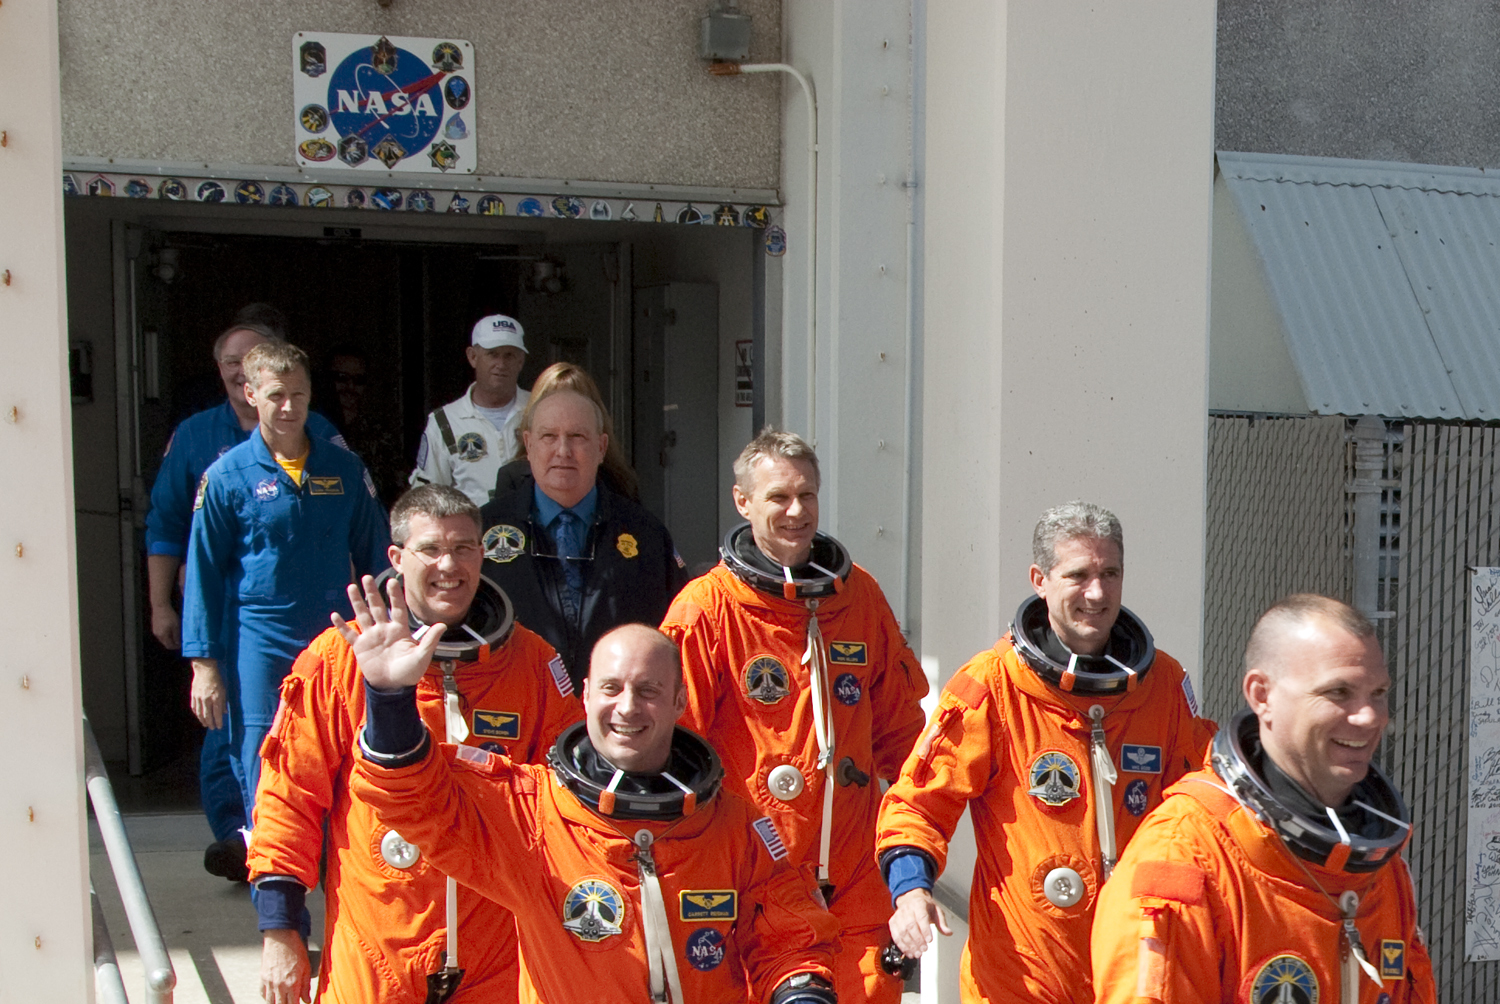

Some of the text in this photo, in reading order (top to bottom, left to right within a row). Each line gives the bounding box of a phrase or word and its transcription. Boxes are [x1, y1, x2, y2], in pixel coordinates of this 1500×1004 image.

[337, 89, 438, 117] NASA
[493, 321, 517, 330] USA
[838, 687, 861, 697] NASA
[692, 945, 723, 957] NASA
